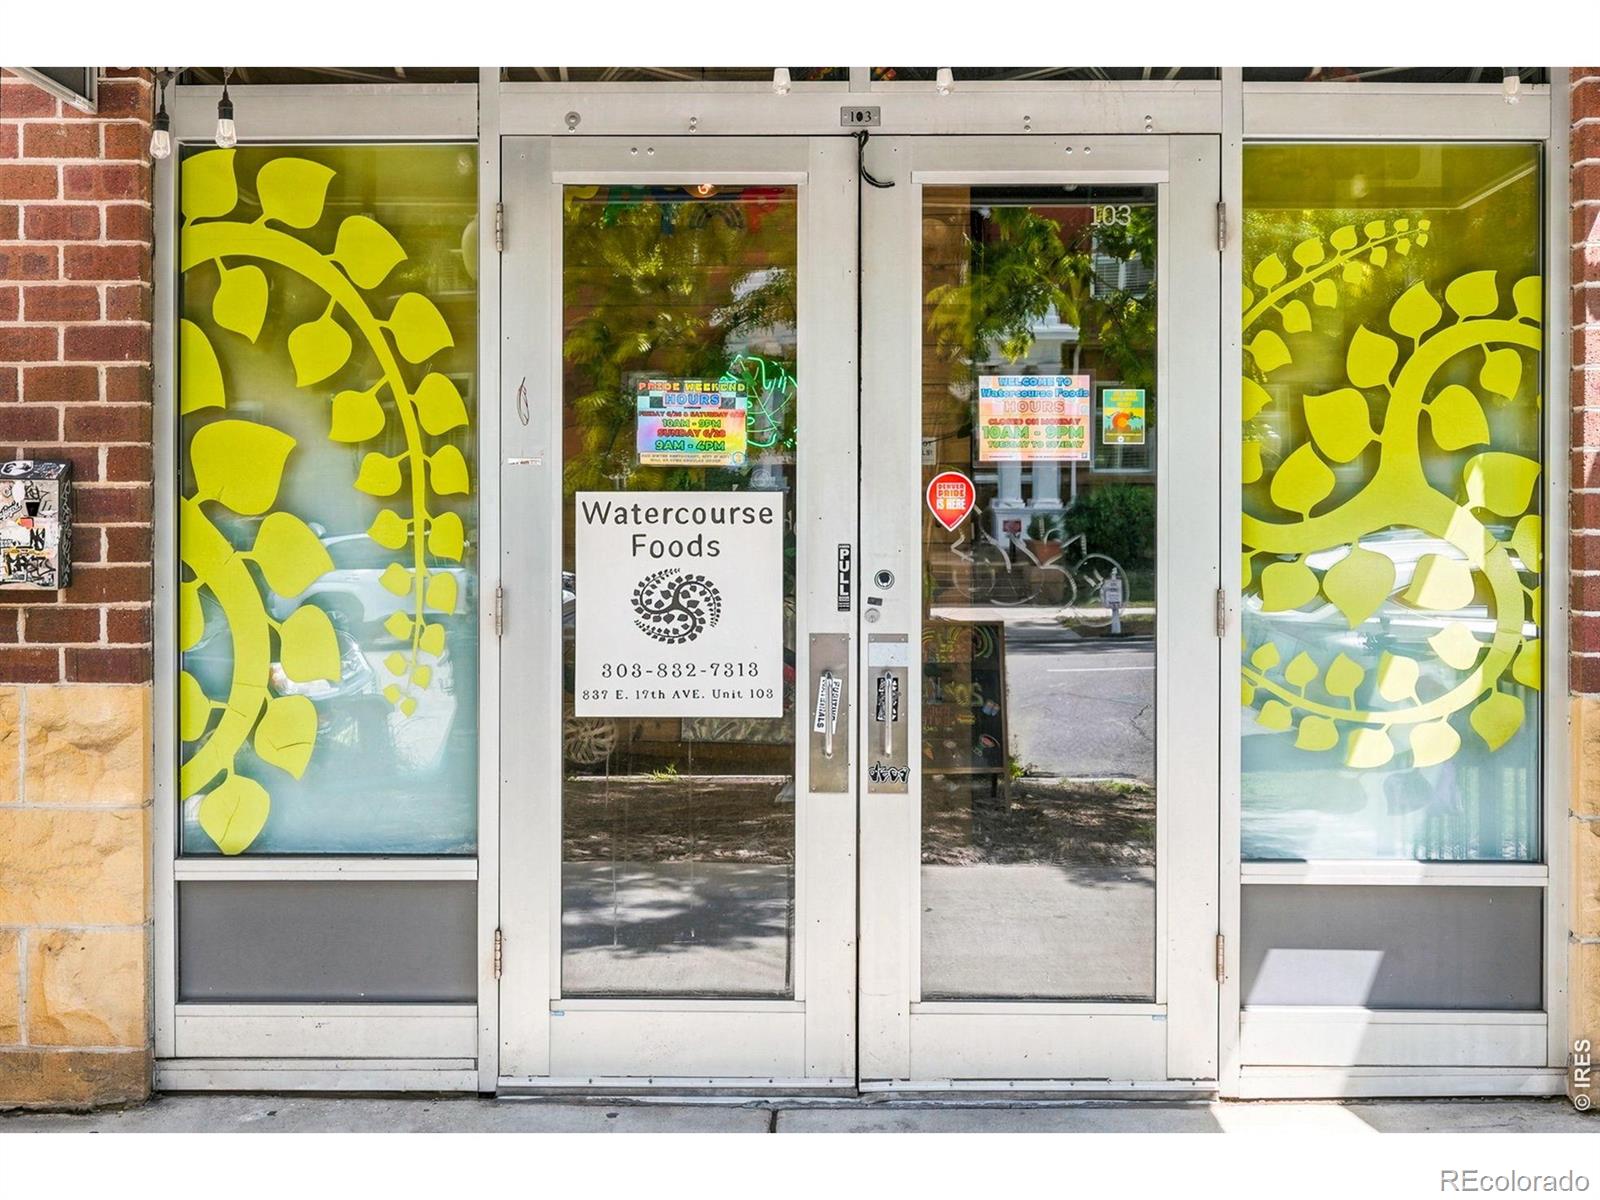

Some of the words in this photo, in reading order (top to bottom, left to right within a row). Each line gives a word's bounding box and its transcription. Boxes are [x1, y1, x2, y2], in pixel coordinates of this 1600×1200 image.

[850, 111, 872, 122] 103
[1090, 205, 1131, 227] 103
[638, 382, 680, 392] PRIDE
[684, 382, 746, 392] WEEKEND
[998, 377, 1054, 387] WELCOME
[1056, 377, 1072, 387] TO
[981, 388, 1053, 398] Watercourse
[1055, 388, 1089, 398] Foods
[664, 393, 721, 406] HOURS
[1003, 400, 1065, 413] HOURS
[663, 419, 690, 428] 10AM
[698, 419, 722, 428] 9PM
[988, 418, 1024, 426] CLOSED
[657, 429, 701, 438] SUNDAY
[982, 426, 1030, 440] 10AM
[1045, 426, 1084, 440] 9PM
[655, 440, 685, 451] 9AM
[695, 440, 726, 452] 4PM
[987, 440, 1030, 449] TUESDAY
[938, 490, 965, 498] PRIDE
[582, 501, 773, 525] Watercourse
[632, 533, 721, 559] Foods
[839, 548, 850, 596] PULL
[602, 662, 759, 678] 303-832-7313
[582, 690, 608, 700] 837
[616, 690, 628, 700] E.
[636, 689, 665, 700] 17th
[672, 689, 704, 700] AVE.
[712, 688, 743, 699] Unit
[750, 688, 774, 699] 103
